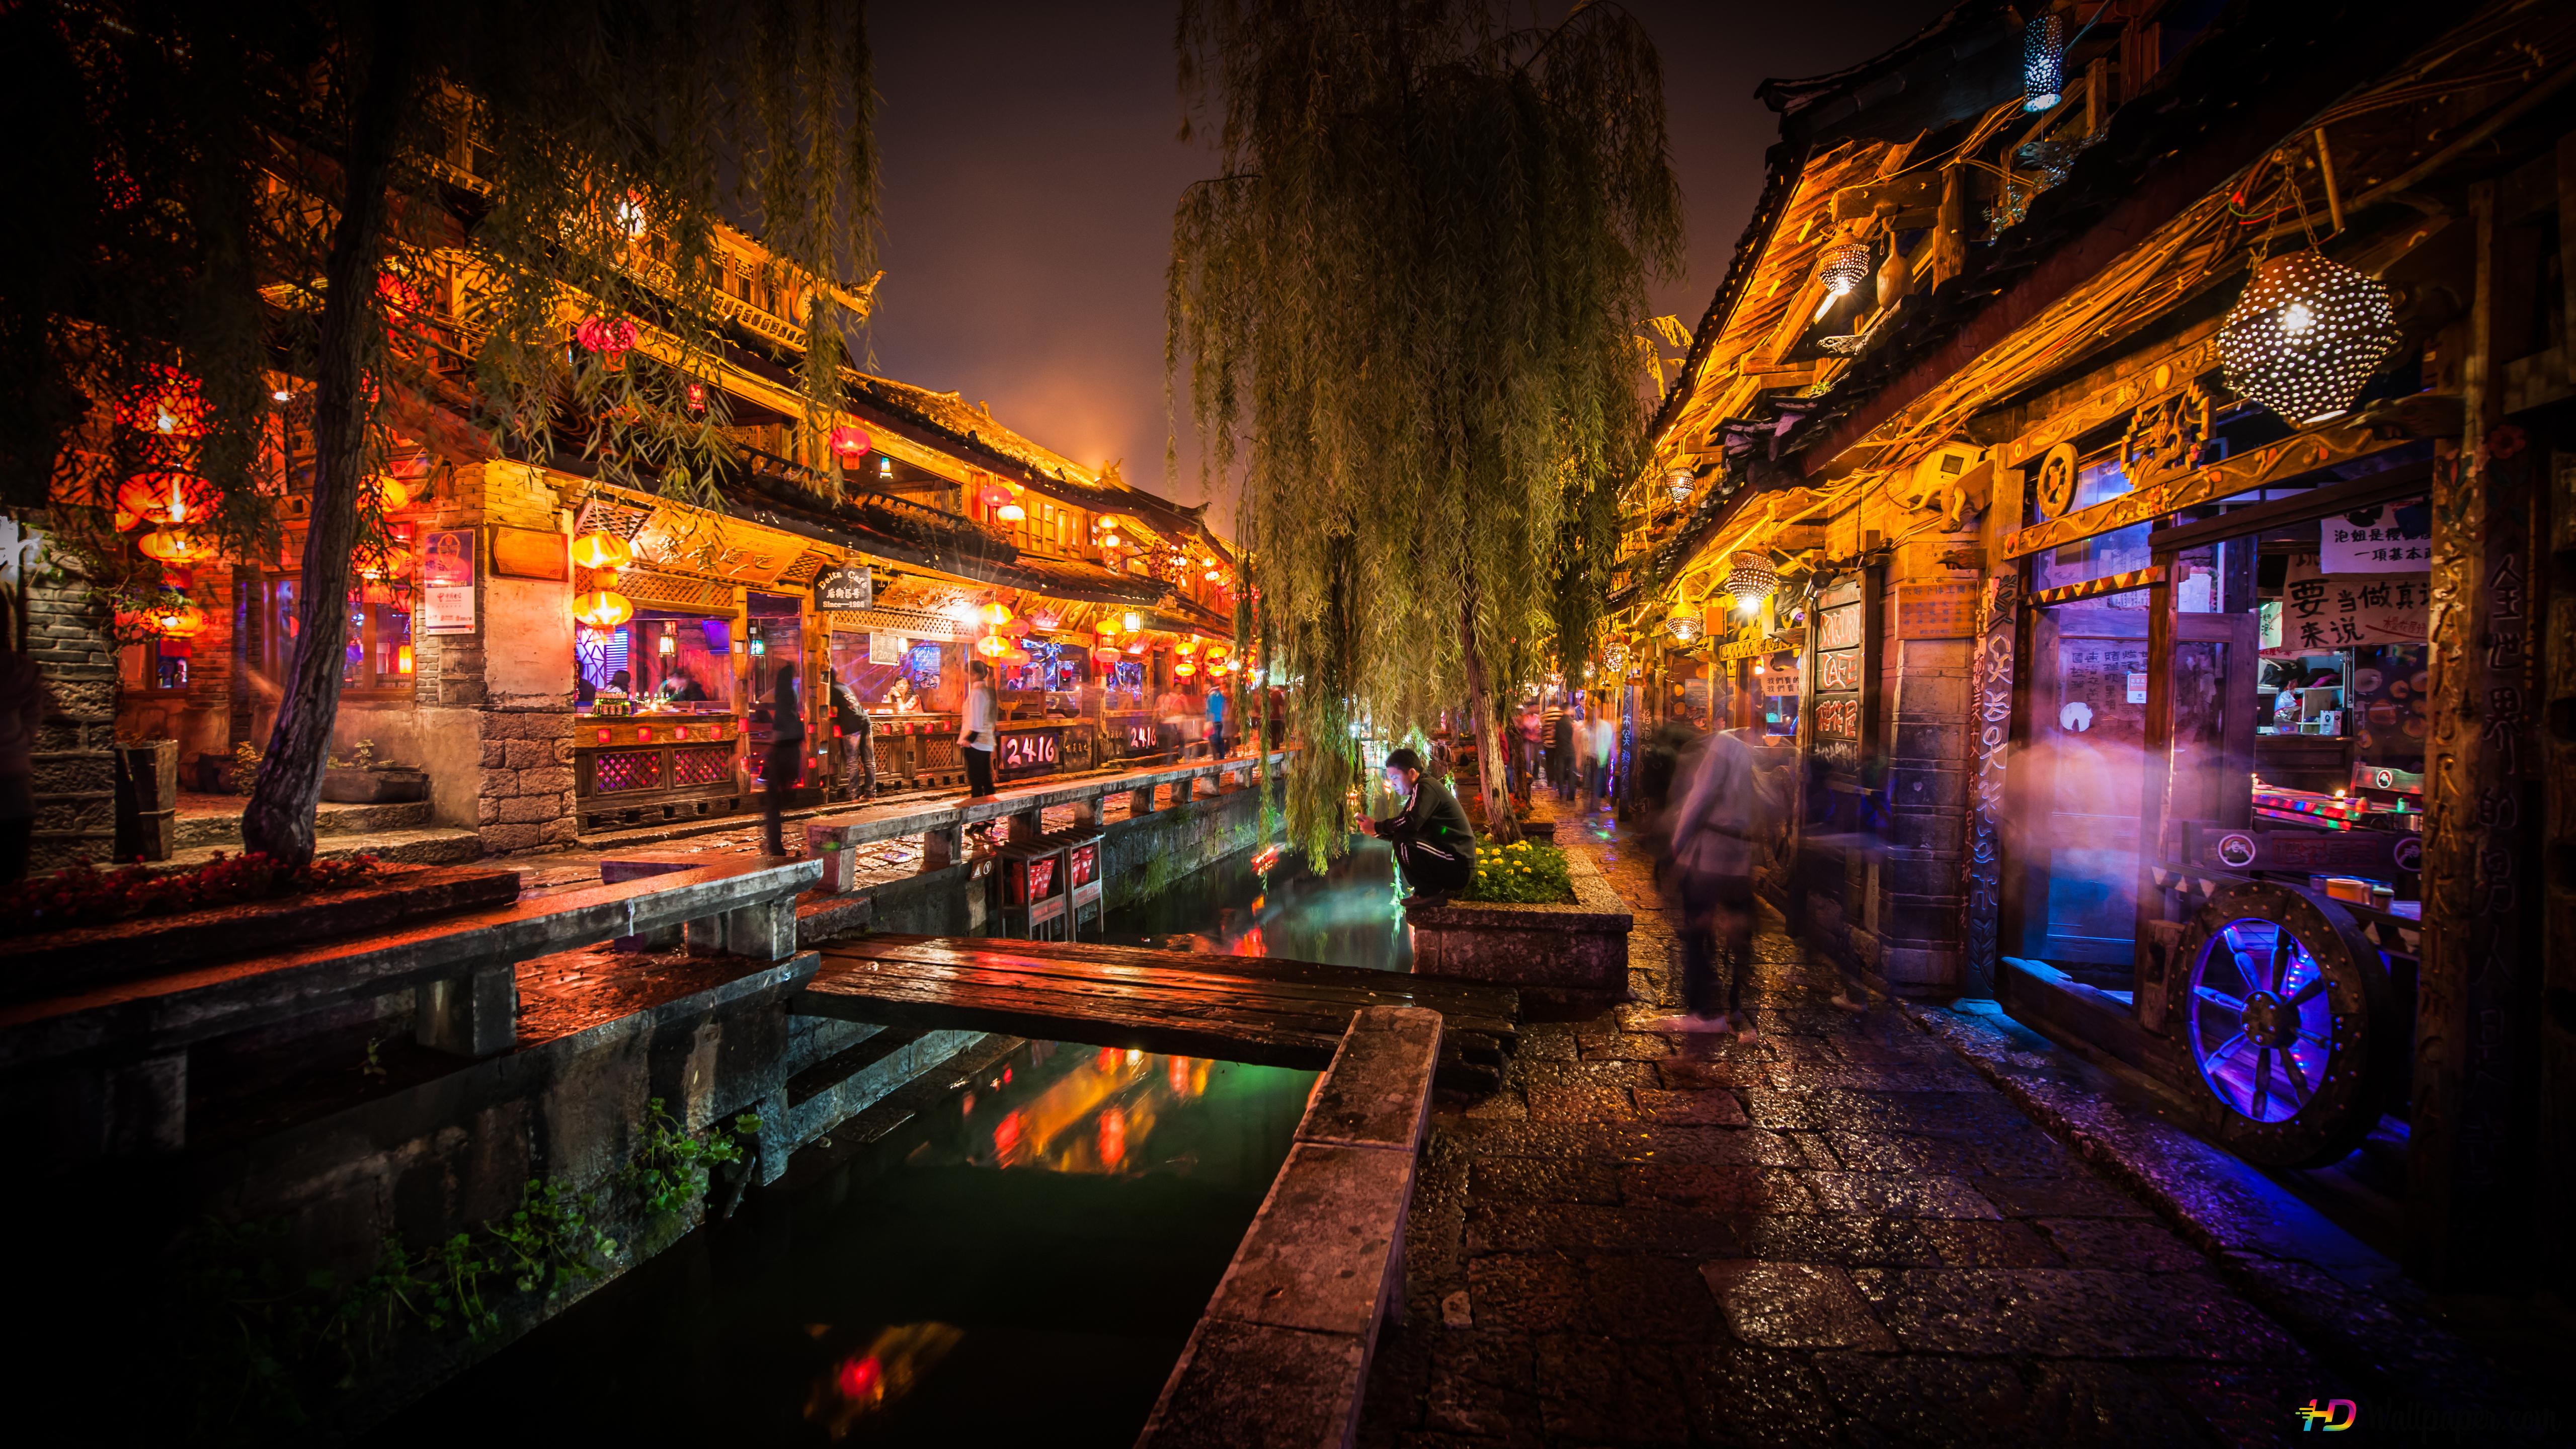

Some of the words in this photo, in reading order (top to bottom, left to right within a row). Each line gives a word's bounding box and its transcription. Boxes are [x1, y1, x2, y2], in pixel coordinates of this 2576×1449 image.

[818, 572, 842, 590] Delta
[827, 588, 860, 599] 后街5号
[1024, 595, 1083, 626] 2416
[1823, 653, 1857, 689] CAFE
[1767, 684, 1799, 692] 我們賣
[1131, 727, 1156, 748] 2416
[1007, 736, 1055, 765] 2416
